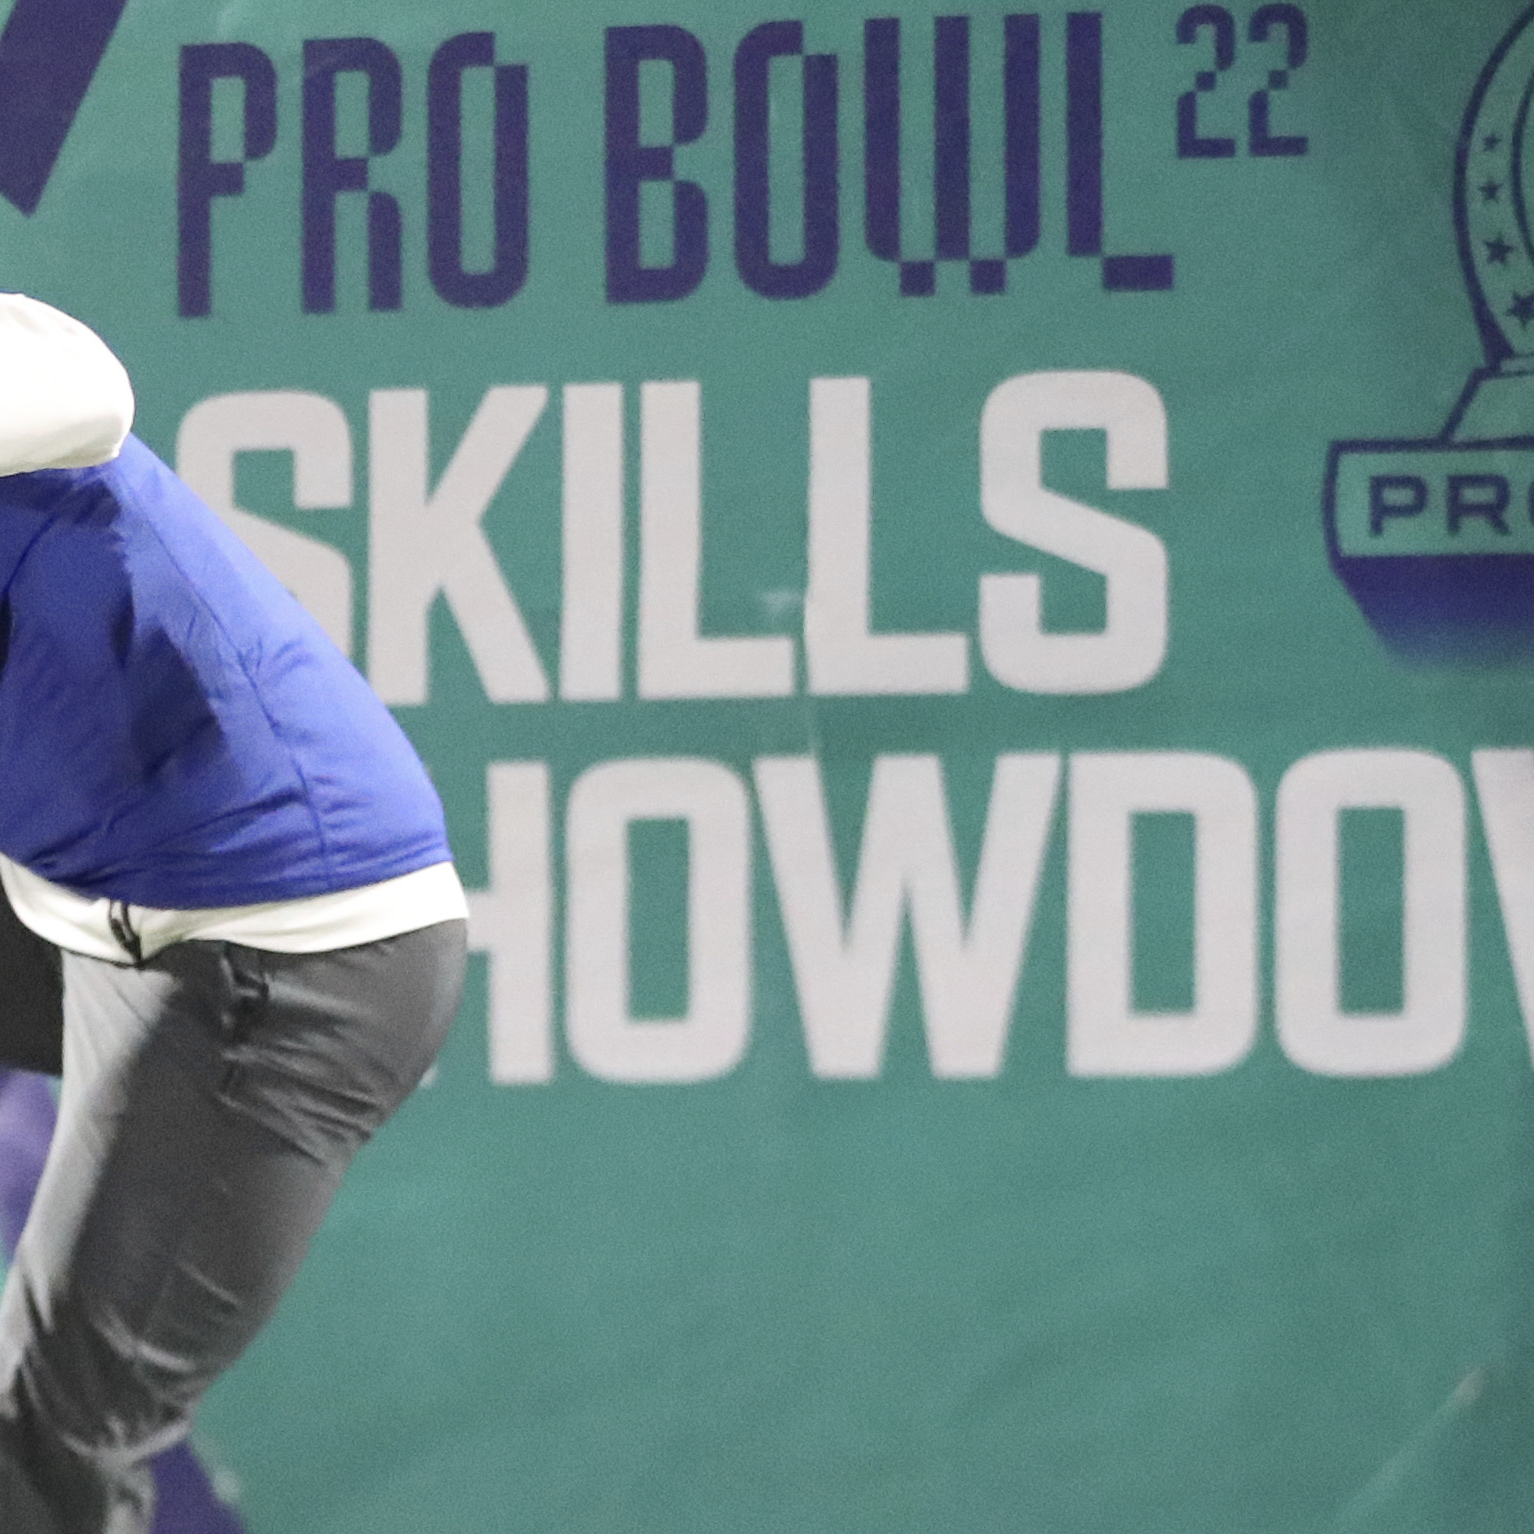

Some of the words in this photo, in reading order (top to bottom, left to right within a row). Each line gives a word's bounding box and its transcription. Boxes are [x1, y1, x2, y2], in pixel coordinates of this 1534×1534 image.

[176, 32, 528, 319] PRO
[603, 11, 1174, 305] BOWL
[1174, 3, 1309, 158] 22
[173, 369, 1169, 706] SKILLS
[1369, 474, 1534, 536] PR
[442, 747, 1534, 1084] HOWDO
